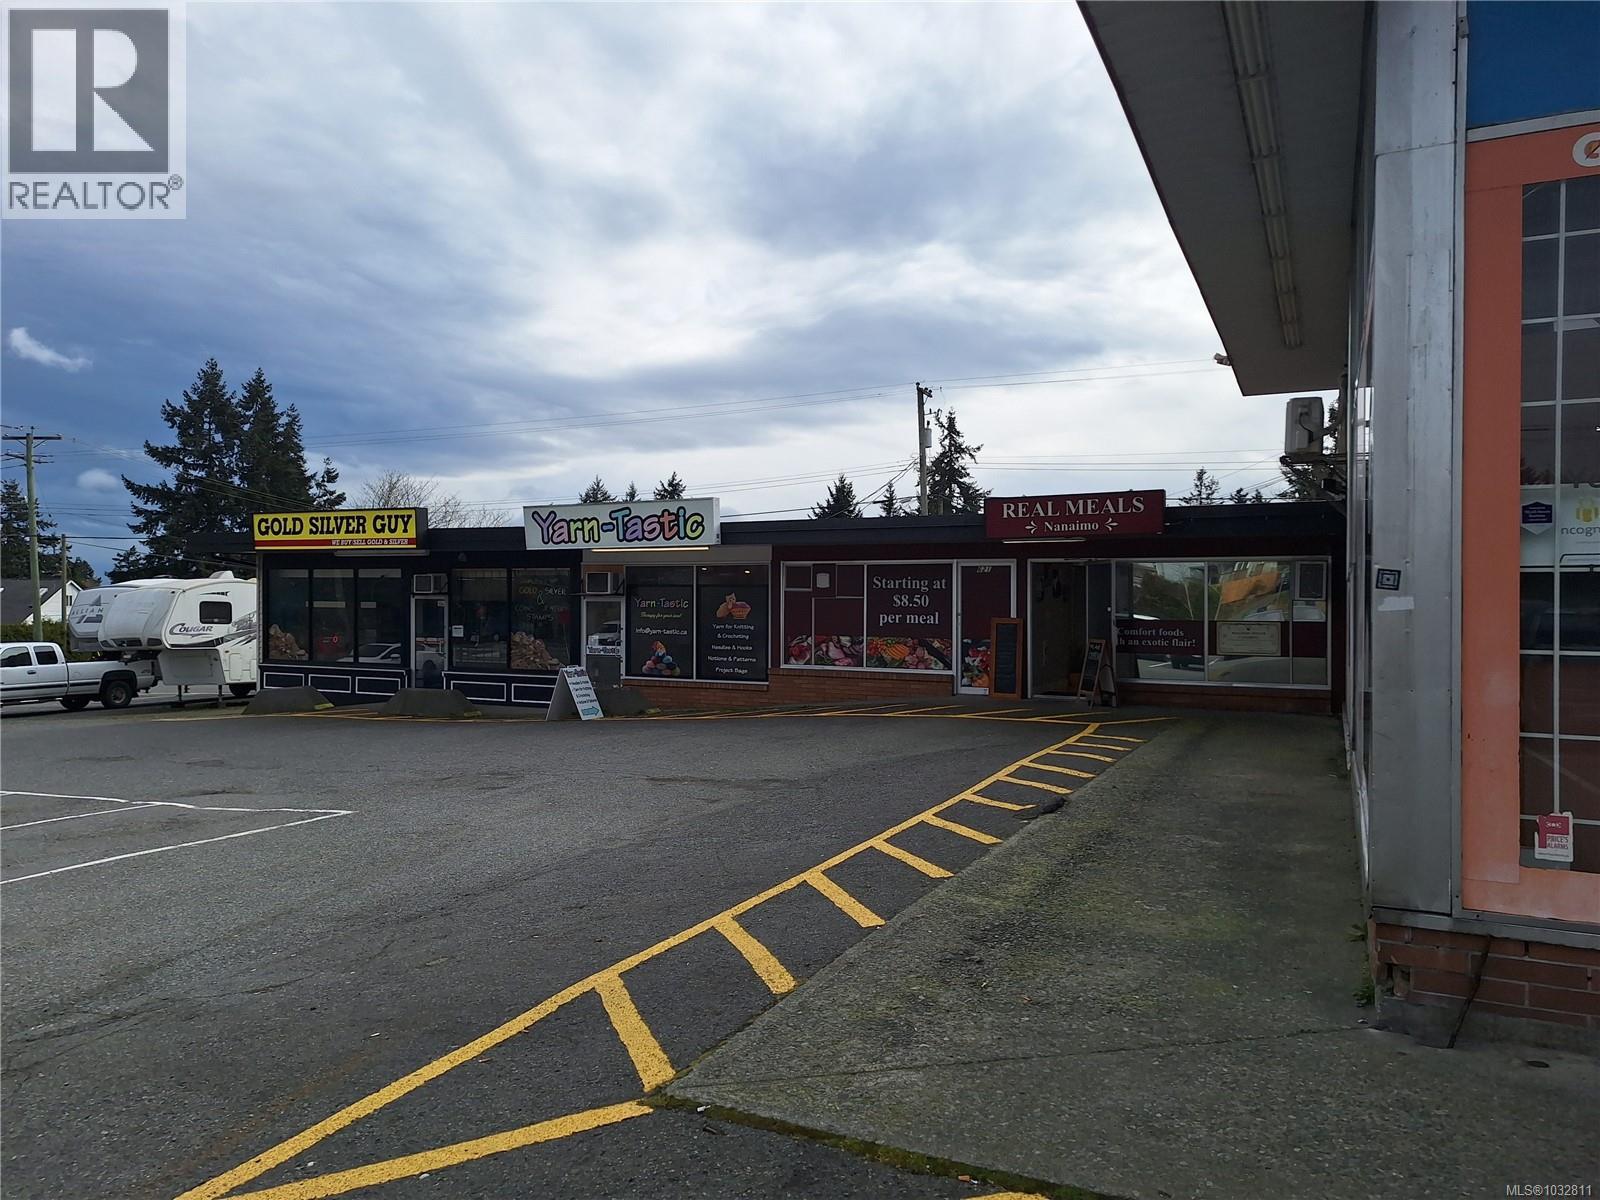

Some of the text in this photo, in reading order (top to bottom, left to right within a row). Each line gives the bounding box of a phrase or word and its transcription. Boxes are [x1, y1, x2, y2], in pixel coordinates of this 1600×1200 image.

[1002, 497, 1144, 518] REAL MEALS
[257, 514, 413, 536] GOLD SILVER GUY
[532, 507, 705, 544] Yarn-Tastic
[1044, 520, 1099, 532] Nanaimo
[873, 575, 947, 593] Starting at
[634, 598, 689, 609] Yarn-Tastic
[892, 594, 930, 608] $8.50
[71, 607, 104, 615] ALLIAN
[879, 611, 939, 627] per meal
[1160, 628, 1185, 637] foods
[1142, 639, 1169, 647] exotic
[1172, 638, 1196, 647] flair!
